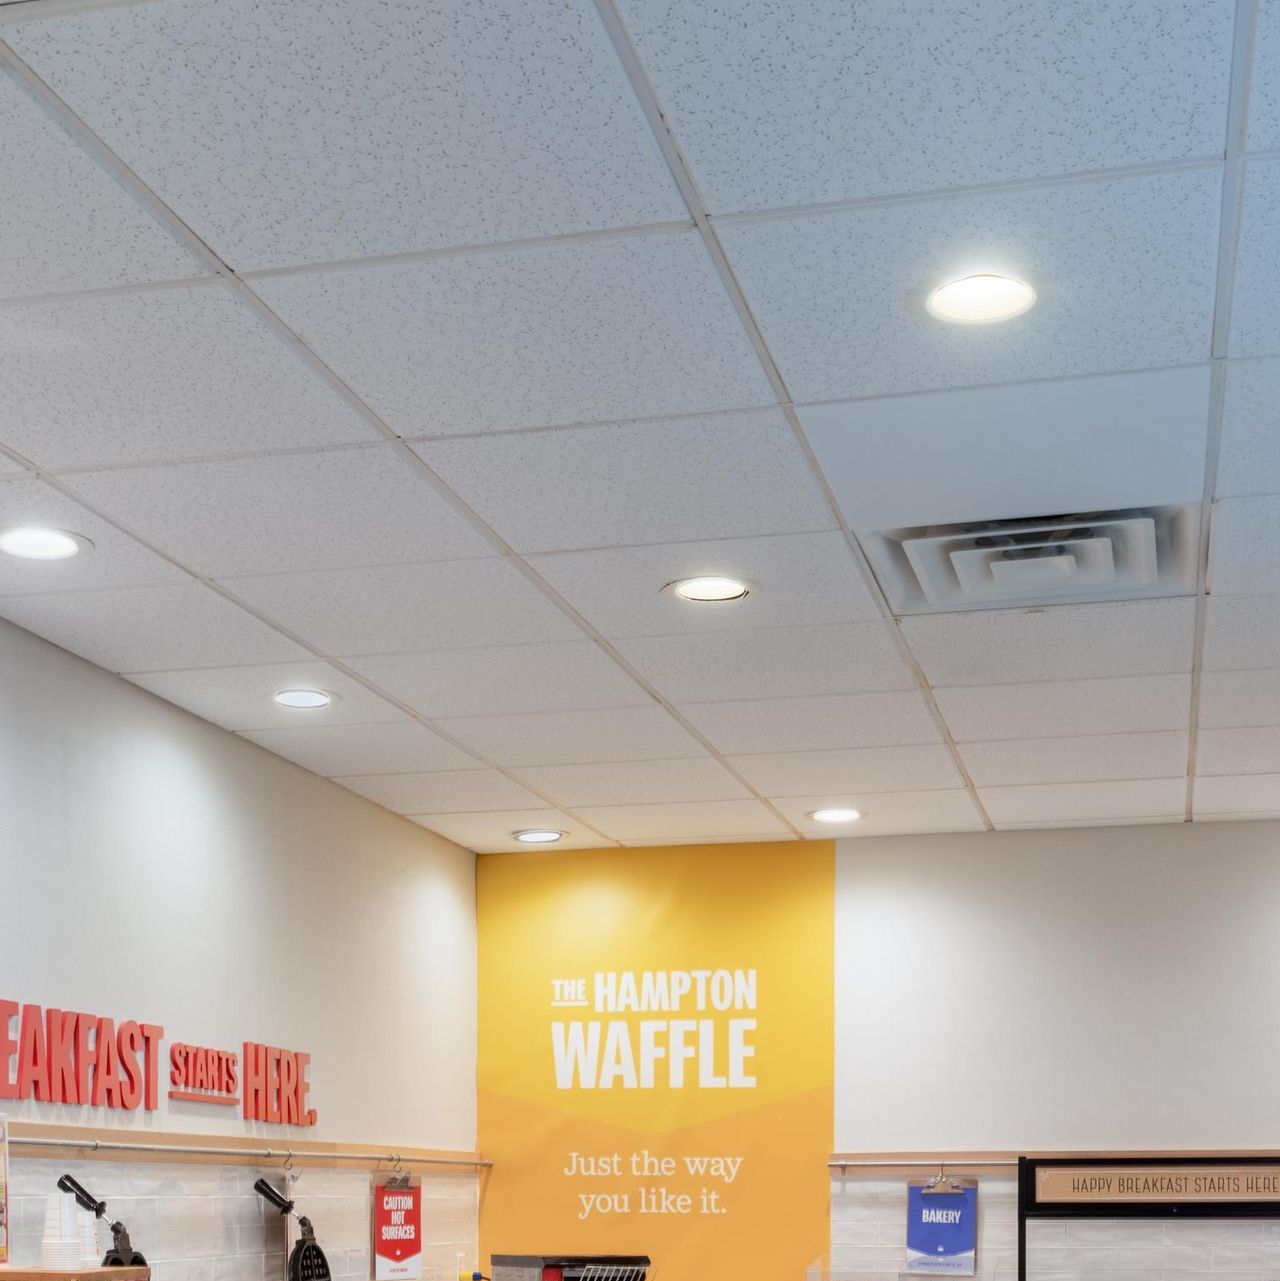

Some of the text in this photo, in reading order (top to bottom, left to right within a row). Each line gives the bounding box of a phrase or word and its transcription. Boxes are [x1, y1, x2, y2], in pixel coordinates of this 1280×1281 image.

[551, 968, 757, 1013] THE HAMPTON
[550, 1018, 758, 1090] WAFFLE
[170, 1042, 238, 1095] STARTS
[243, 1041, 318, 1128] HERE.
[563, 1149, 745, 1184] Just the way
[1071, 1175, 1280, 1194] HAPPY BREAKFAST STARTS HERE
[383, 1195, 413, 1211] CAUTION
[577, 1186, 728, 1221] you like it.
[922, 1208, 962, 1224] BAKERY
[391, 1211, 405, 1225] HOT
[382, 1225, 415, 1240] SURFACES
